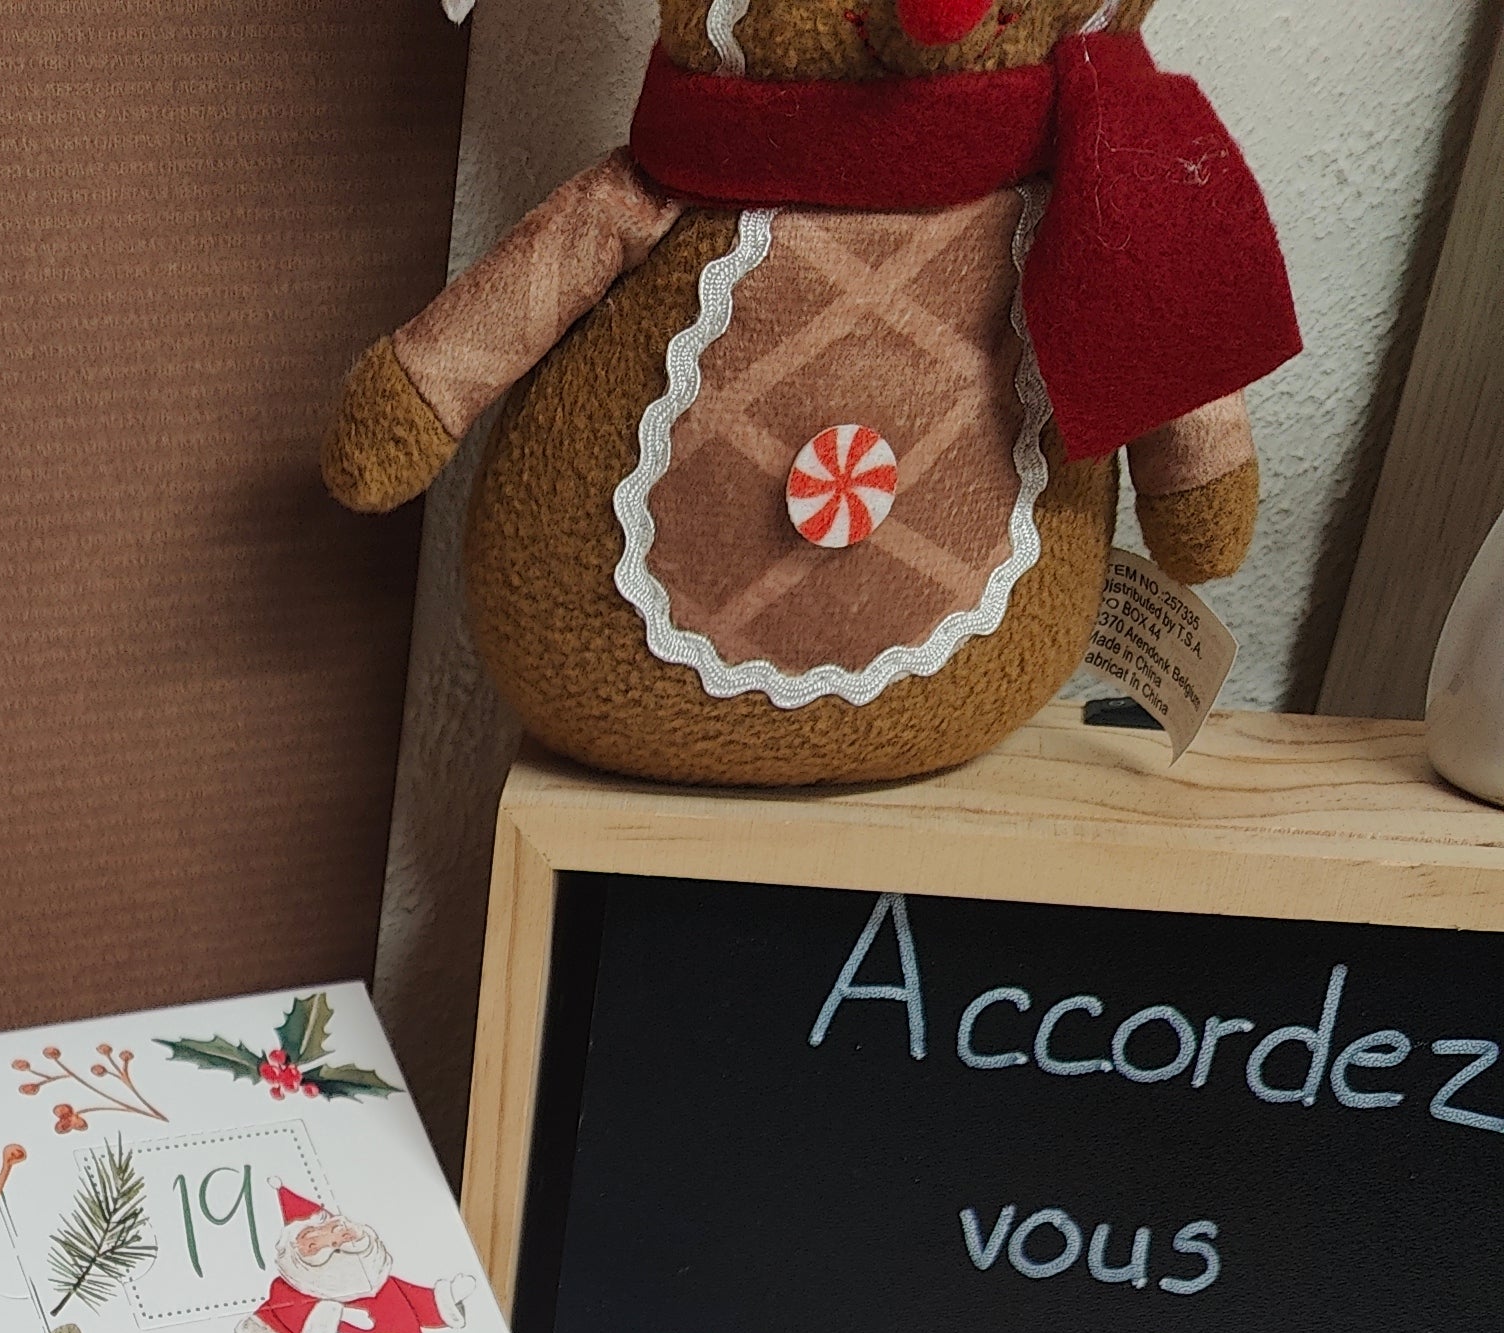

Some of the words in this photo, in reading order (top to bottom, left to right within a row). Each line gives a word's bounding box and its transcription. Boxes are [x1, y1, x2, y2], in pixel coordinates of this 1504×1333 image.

[1106, 563, 1137, 583] TEM
[1121, 600, 1148, 631] BOX
[1148, 622, 1162, 642] 44
[1161, 611, 1176, 634] by
[1176, 623, 1203, 660] T.S.A.
[1122, 645, 1134, 664] in
[1135, 655, 1163, 689] China
[1124, 626, 1171, 675] Arendonk
[1084, 651, 1129, 683] abricat
[1141, 683, 1169, 716] China
[808, 892, 1504, 1135] Accordez
[172, 1163, 266, 1278] 19
[959, 1204, 1222, 1296] vous
